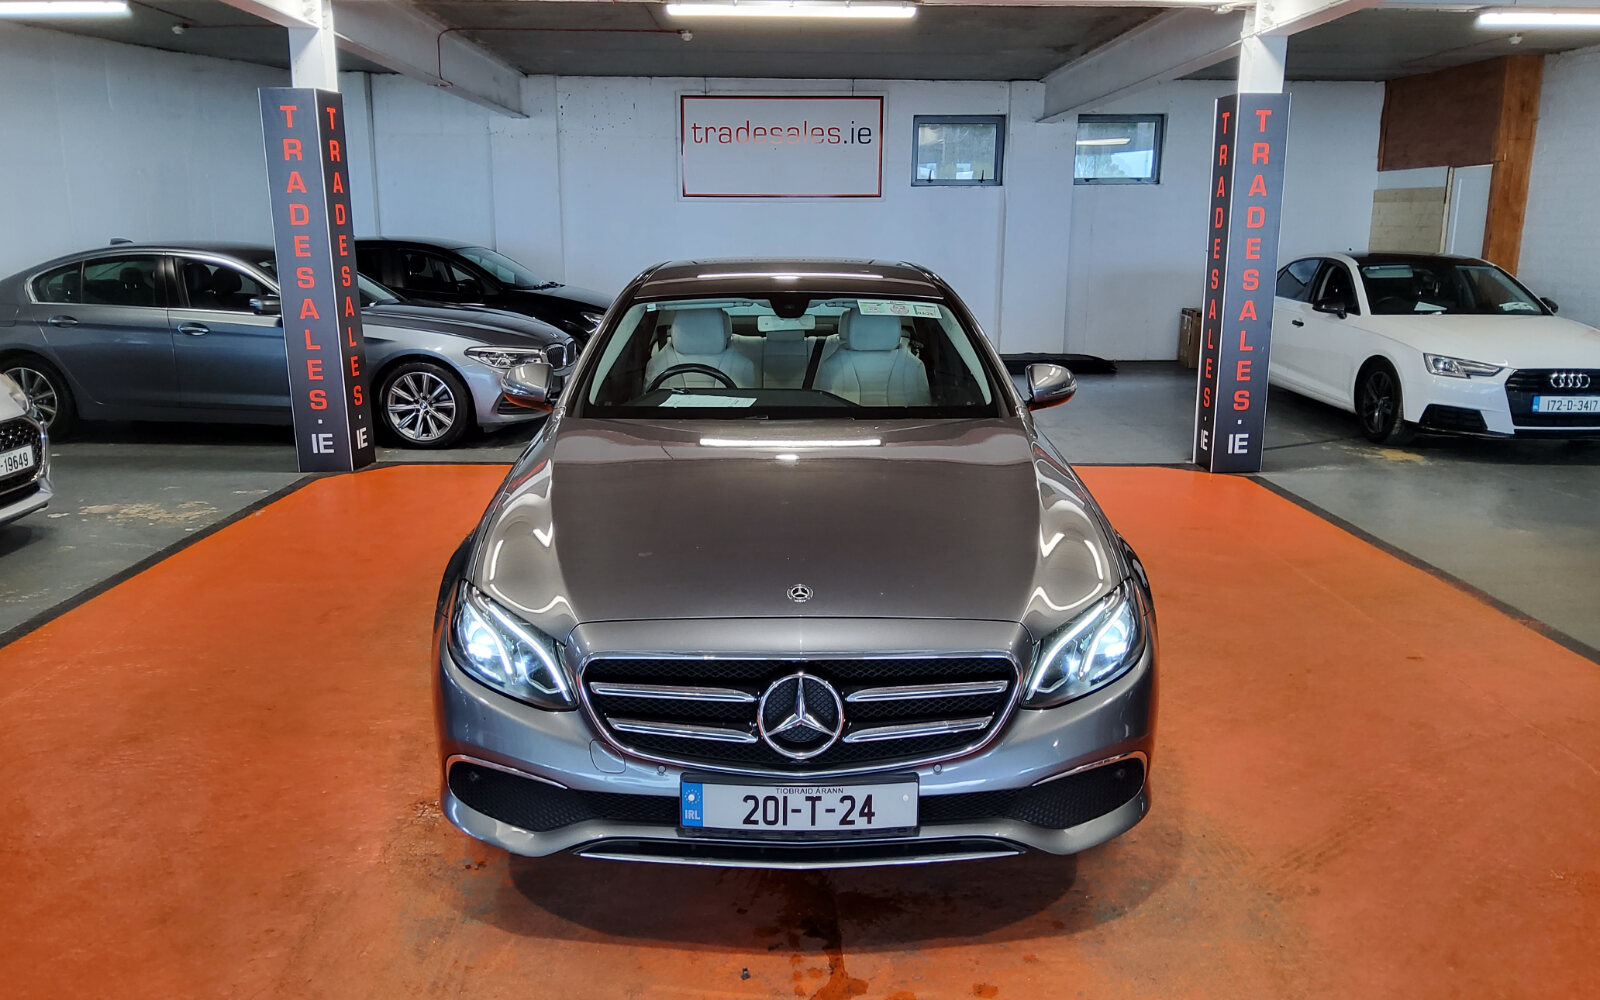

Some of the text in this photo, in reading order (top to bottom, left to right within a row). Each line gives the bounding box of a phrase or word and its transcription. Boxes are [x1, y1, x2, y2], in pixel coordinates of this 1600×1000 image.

[692, 120, 872, 144] tradesales.ie
[684, 809, 701, 820] IRL
[742, 794, 876, 826] 201-T-24
